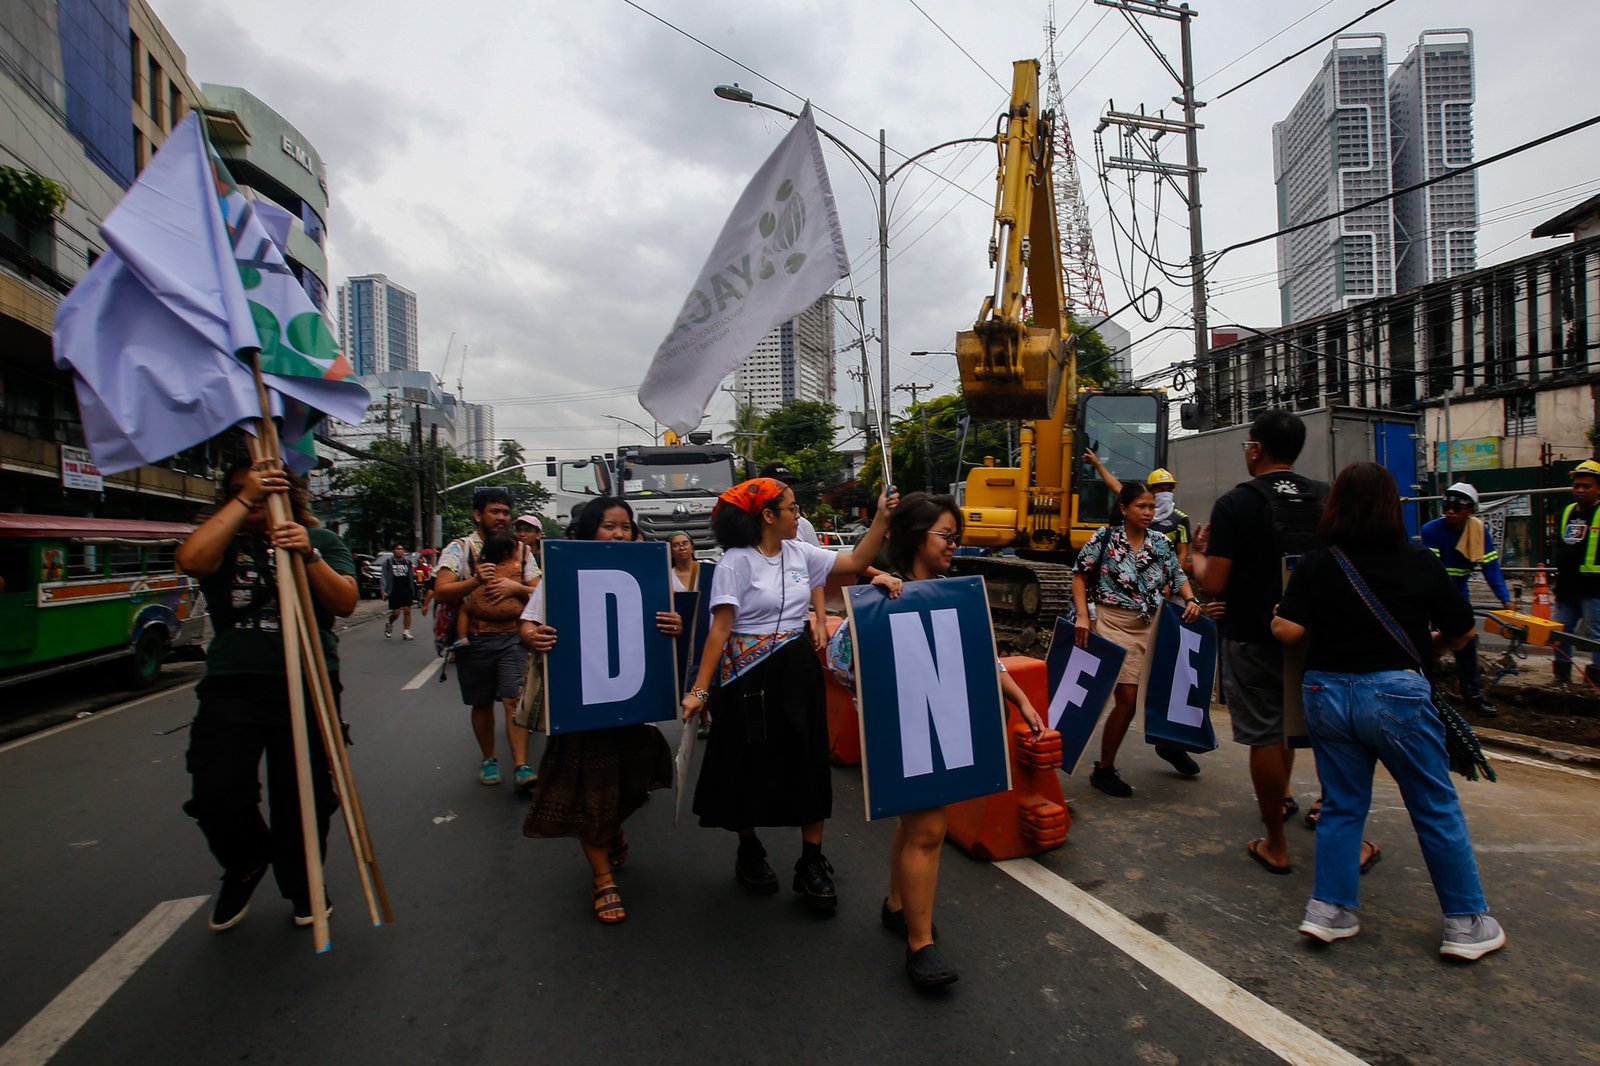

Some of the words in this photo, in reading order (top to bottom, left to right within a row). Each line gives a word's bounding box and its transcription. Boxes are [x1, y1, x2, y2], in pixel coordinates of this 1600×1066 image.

[577, 569, 646, 705] D
[889, 608, 974, 778] N
[1048, 645, 1101, 730] F
[1167, 625, 1204, 728] E
